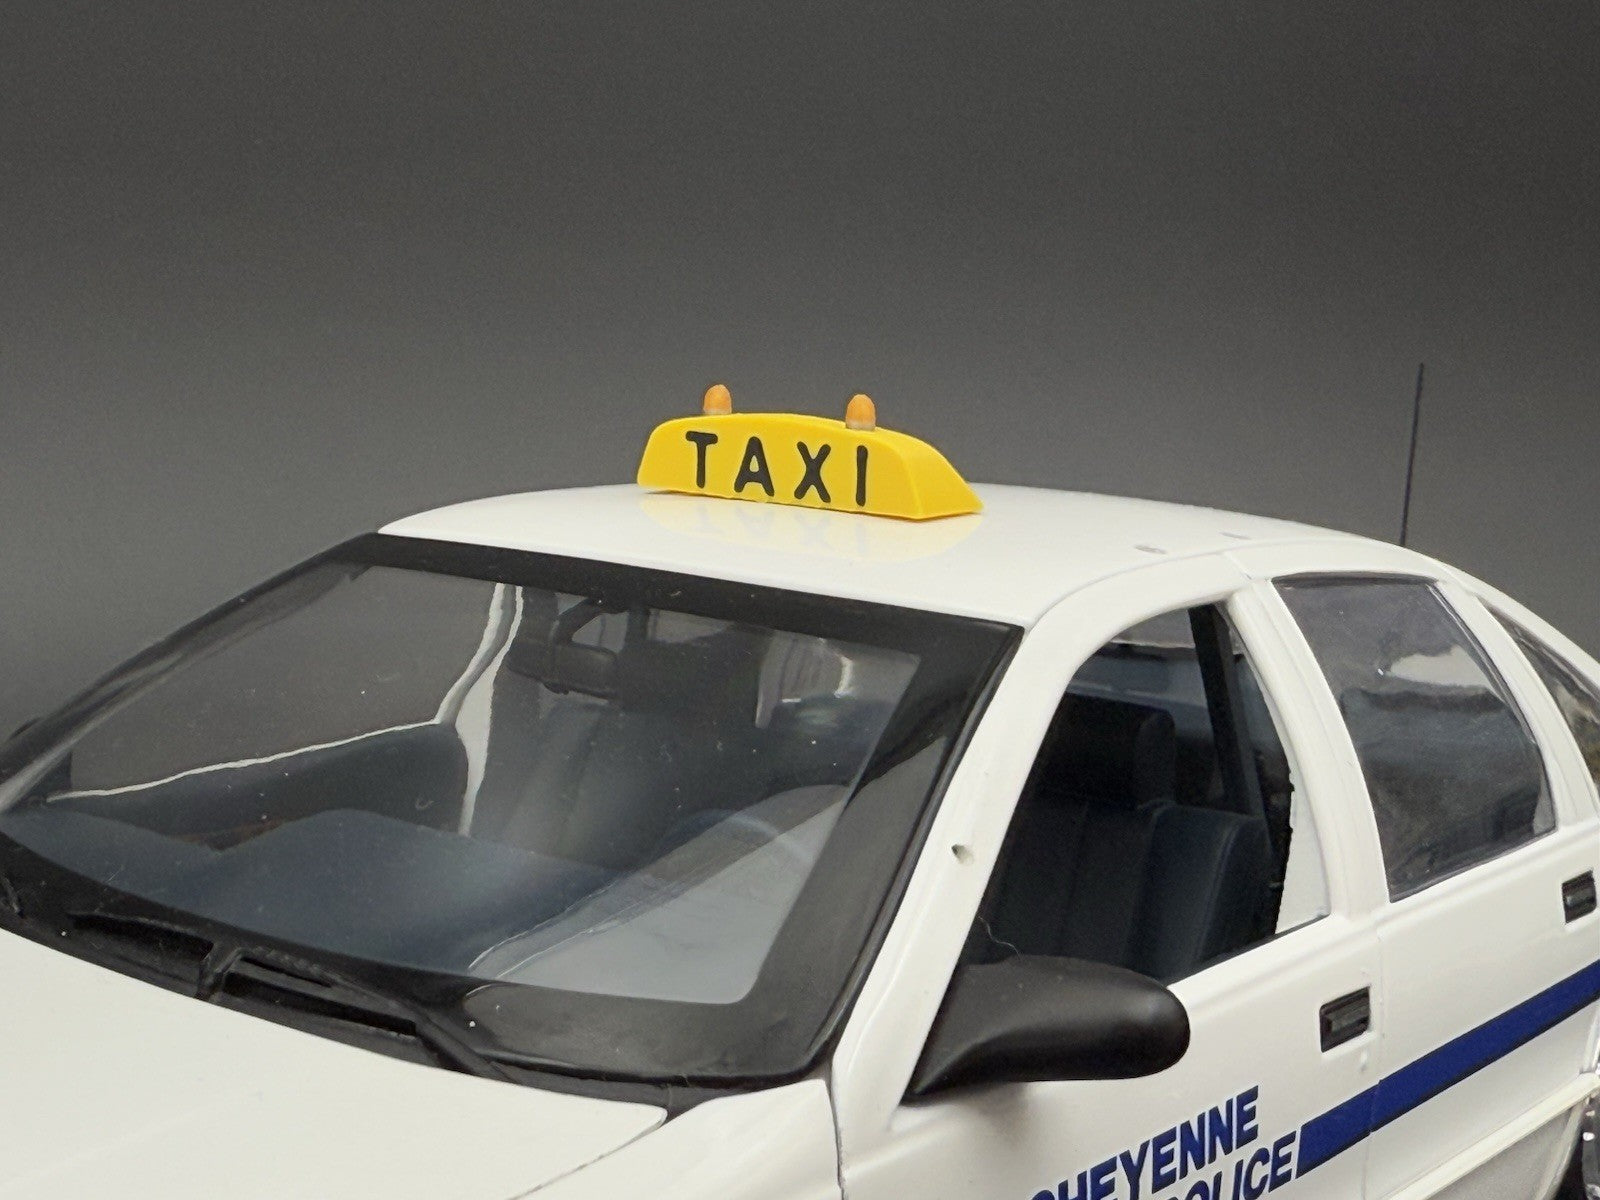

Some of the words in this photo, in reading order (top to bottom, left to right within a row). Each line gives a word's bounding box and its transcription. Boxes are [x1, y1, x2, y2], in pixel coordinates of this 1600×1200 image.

[686, 430, 869, 507] TAXI
[1031, 1085, 1258, 1200] EYENNE
[1166, 1130, 1297, 1200] ICE
